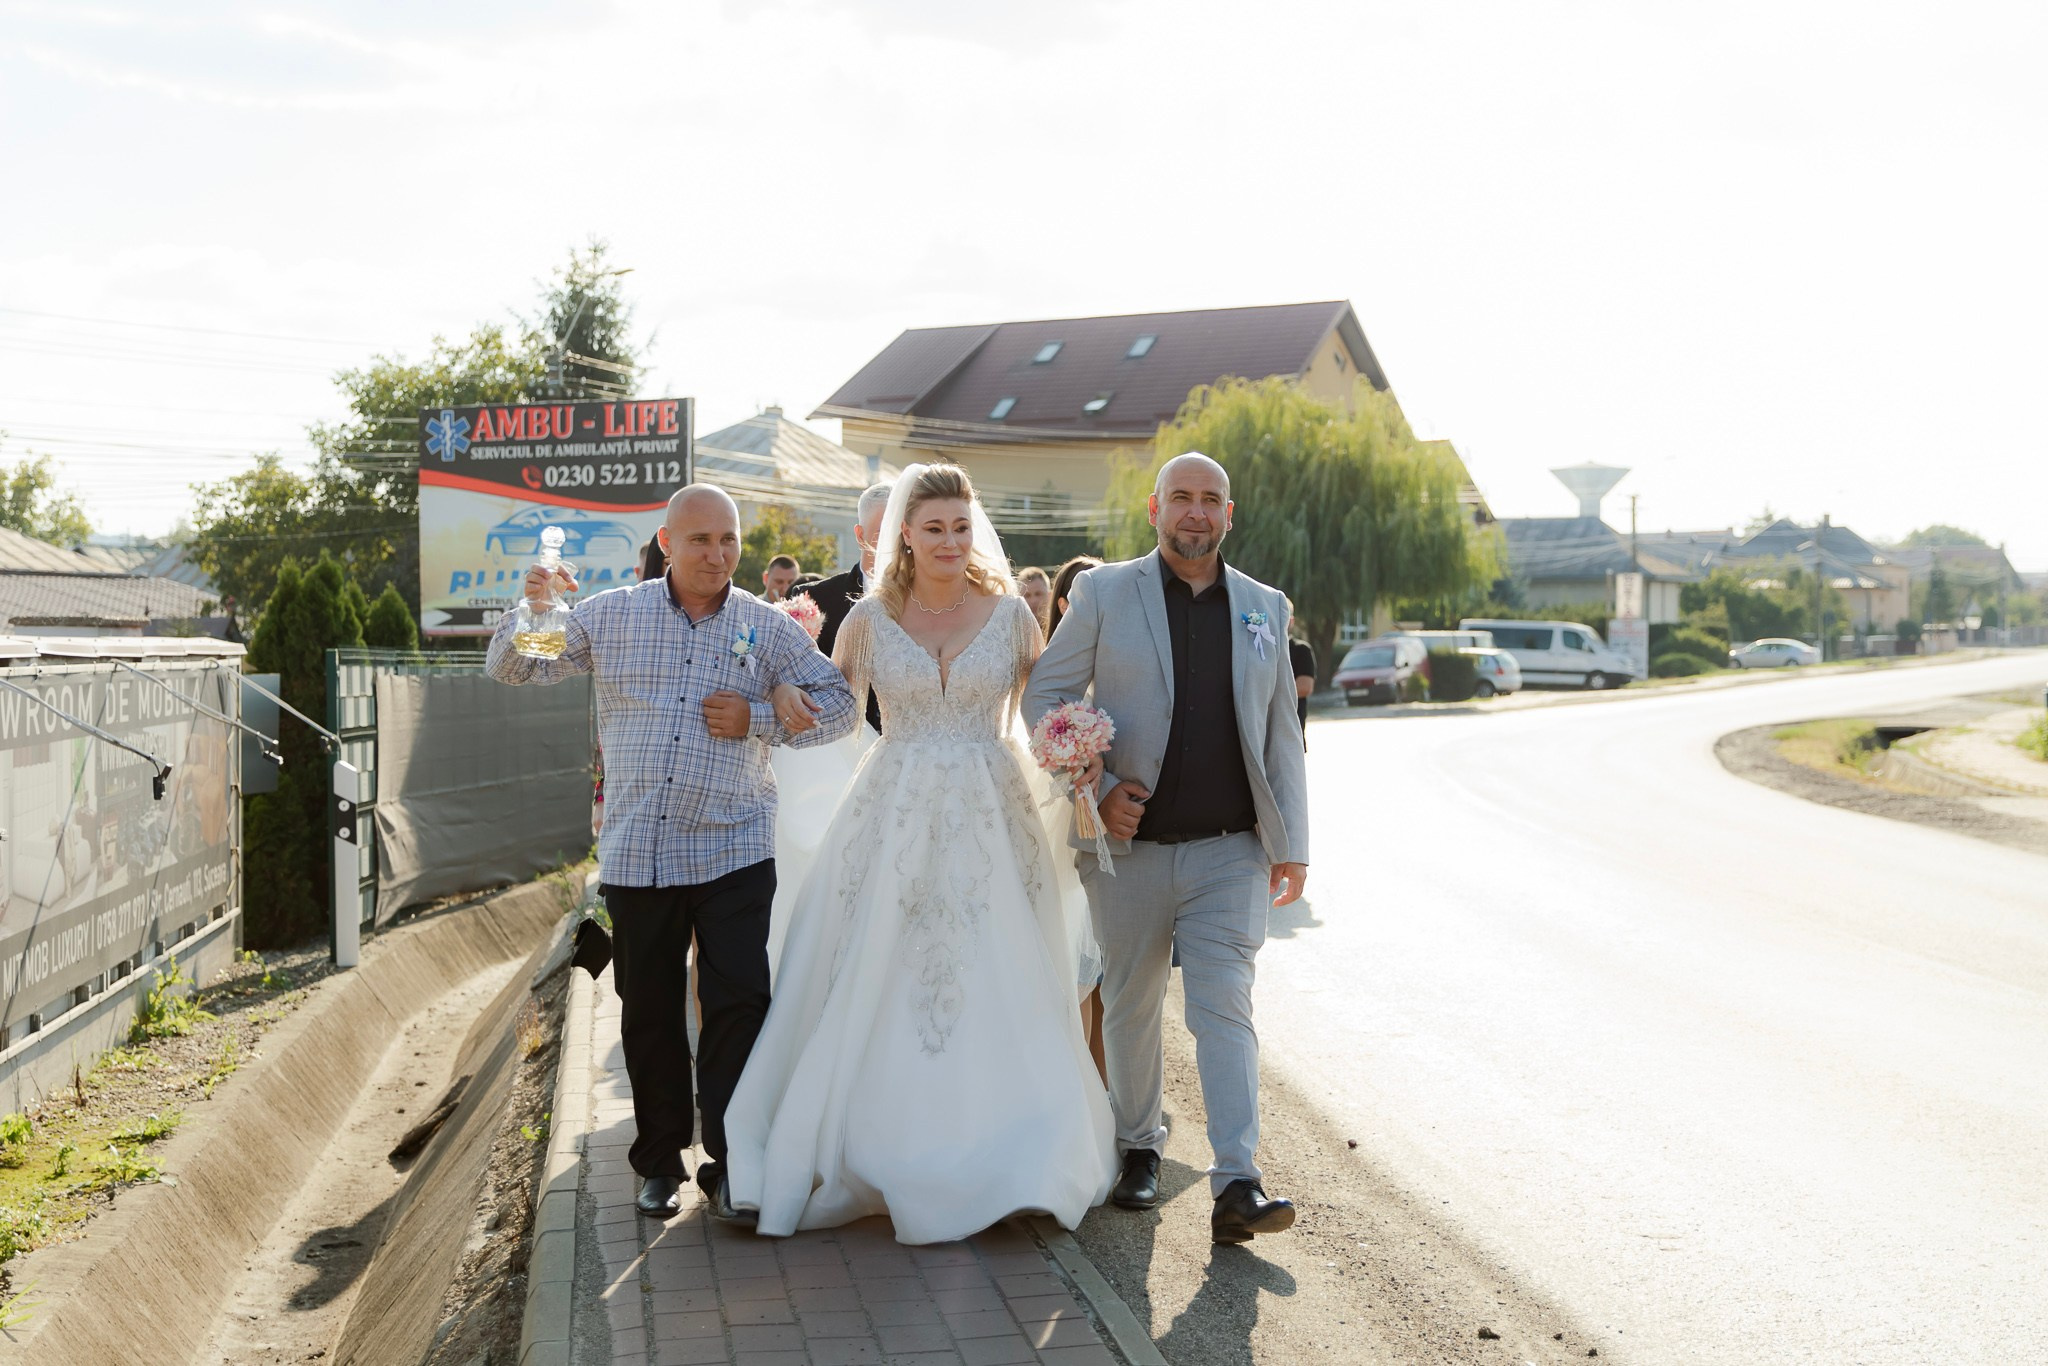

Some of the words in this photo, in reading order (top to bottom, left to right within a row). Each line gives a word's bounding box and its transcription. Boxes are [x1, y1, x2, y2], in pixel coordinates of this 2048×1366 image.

[471, 406, 575, 442] AMBU
[603, 401, 680, 438] LIFE
[470, 445, 534, 461] SERVICIUL
[535, 444, 553, 459] DE
[553, 439, 632, 458] AMBULANȚĂ
[634, 439, 680, 454] PRIVAT
[544, 464, 596, 488] 0230
[599, 462, 638, 486] 522
[643, 461, 681, 484] 112
[106, 681, 130, 724] DE
[3, 952, 23, 1000] MIT
[25, 941, 48, 988] MOB
[52, 920, 90, 974] LUXURY
[97, 908, 117, 951] 0758
